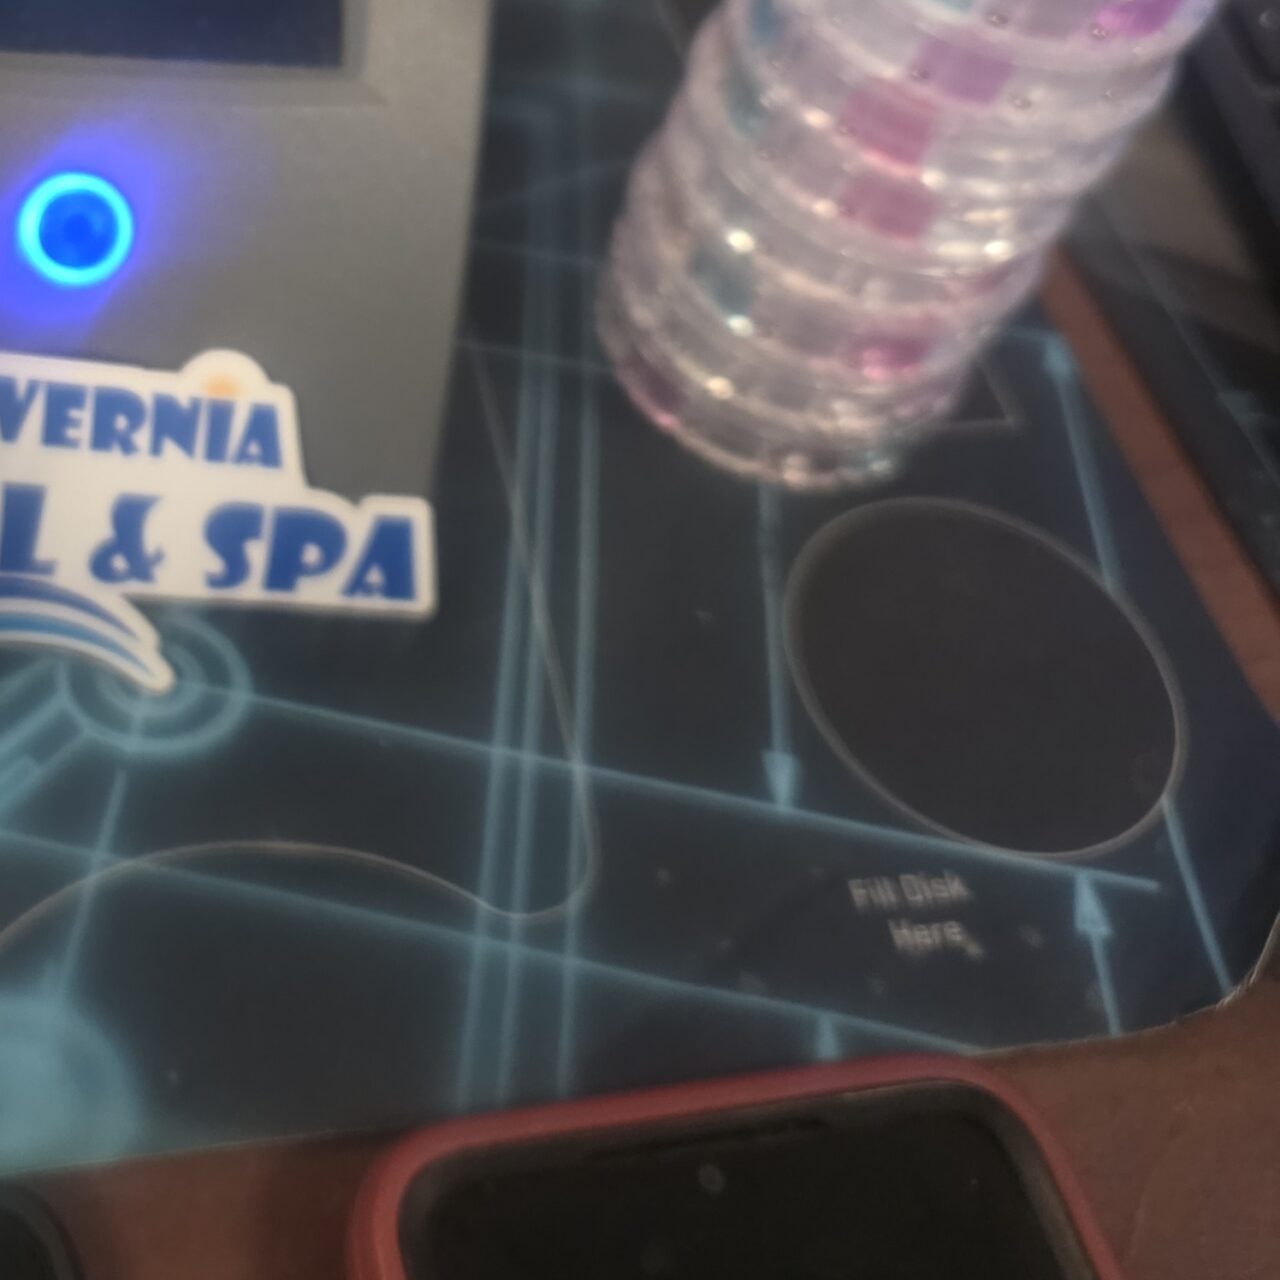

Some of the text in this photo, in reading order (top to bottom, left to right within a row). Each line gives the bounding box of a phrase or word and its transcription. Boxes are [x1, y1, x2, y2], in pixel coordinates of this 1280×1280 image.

[88, 493, 167, 585] &
[202, 500, 418, 602] SPA
[848, 872, 970, 908] Fill Disk
